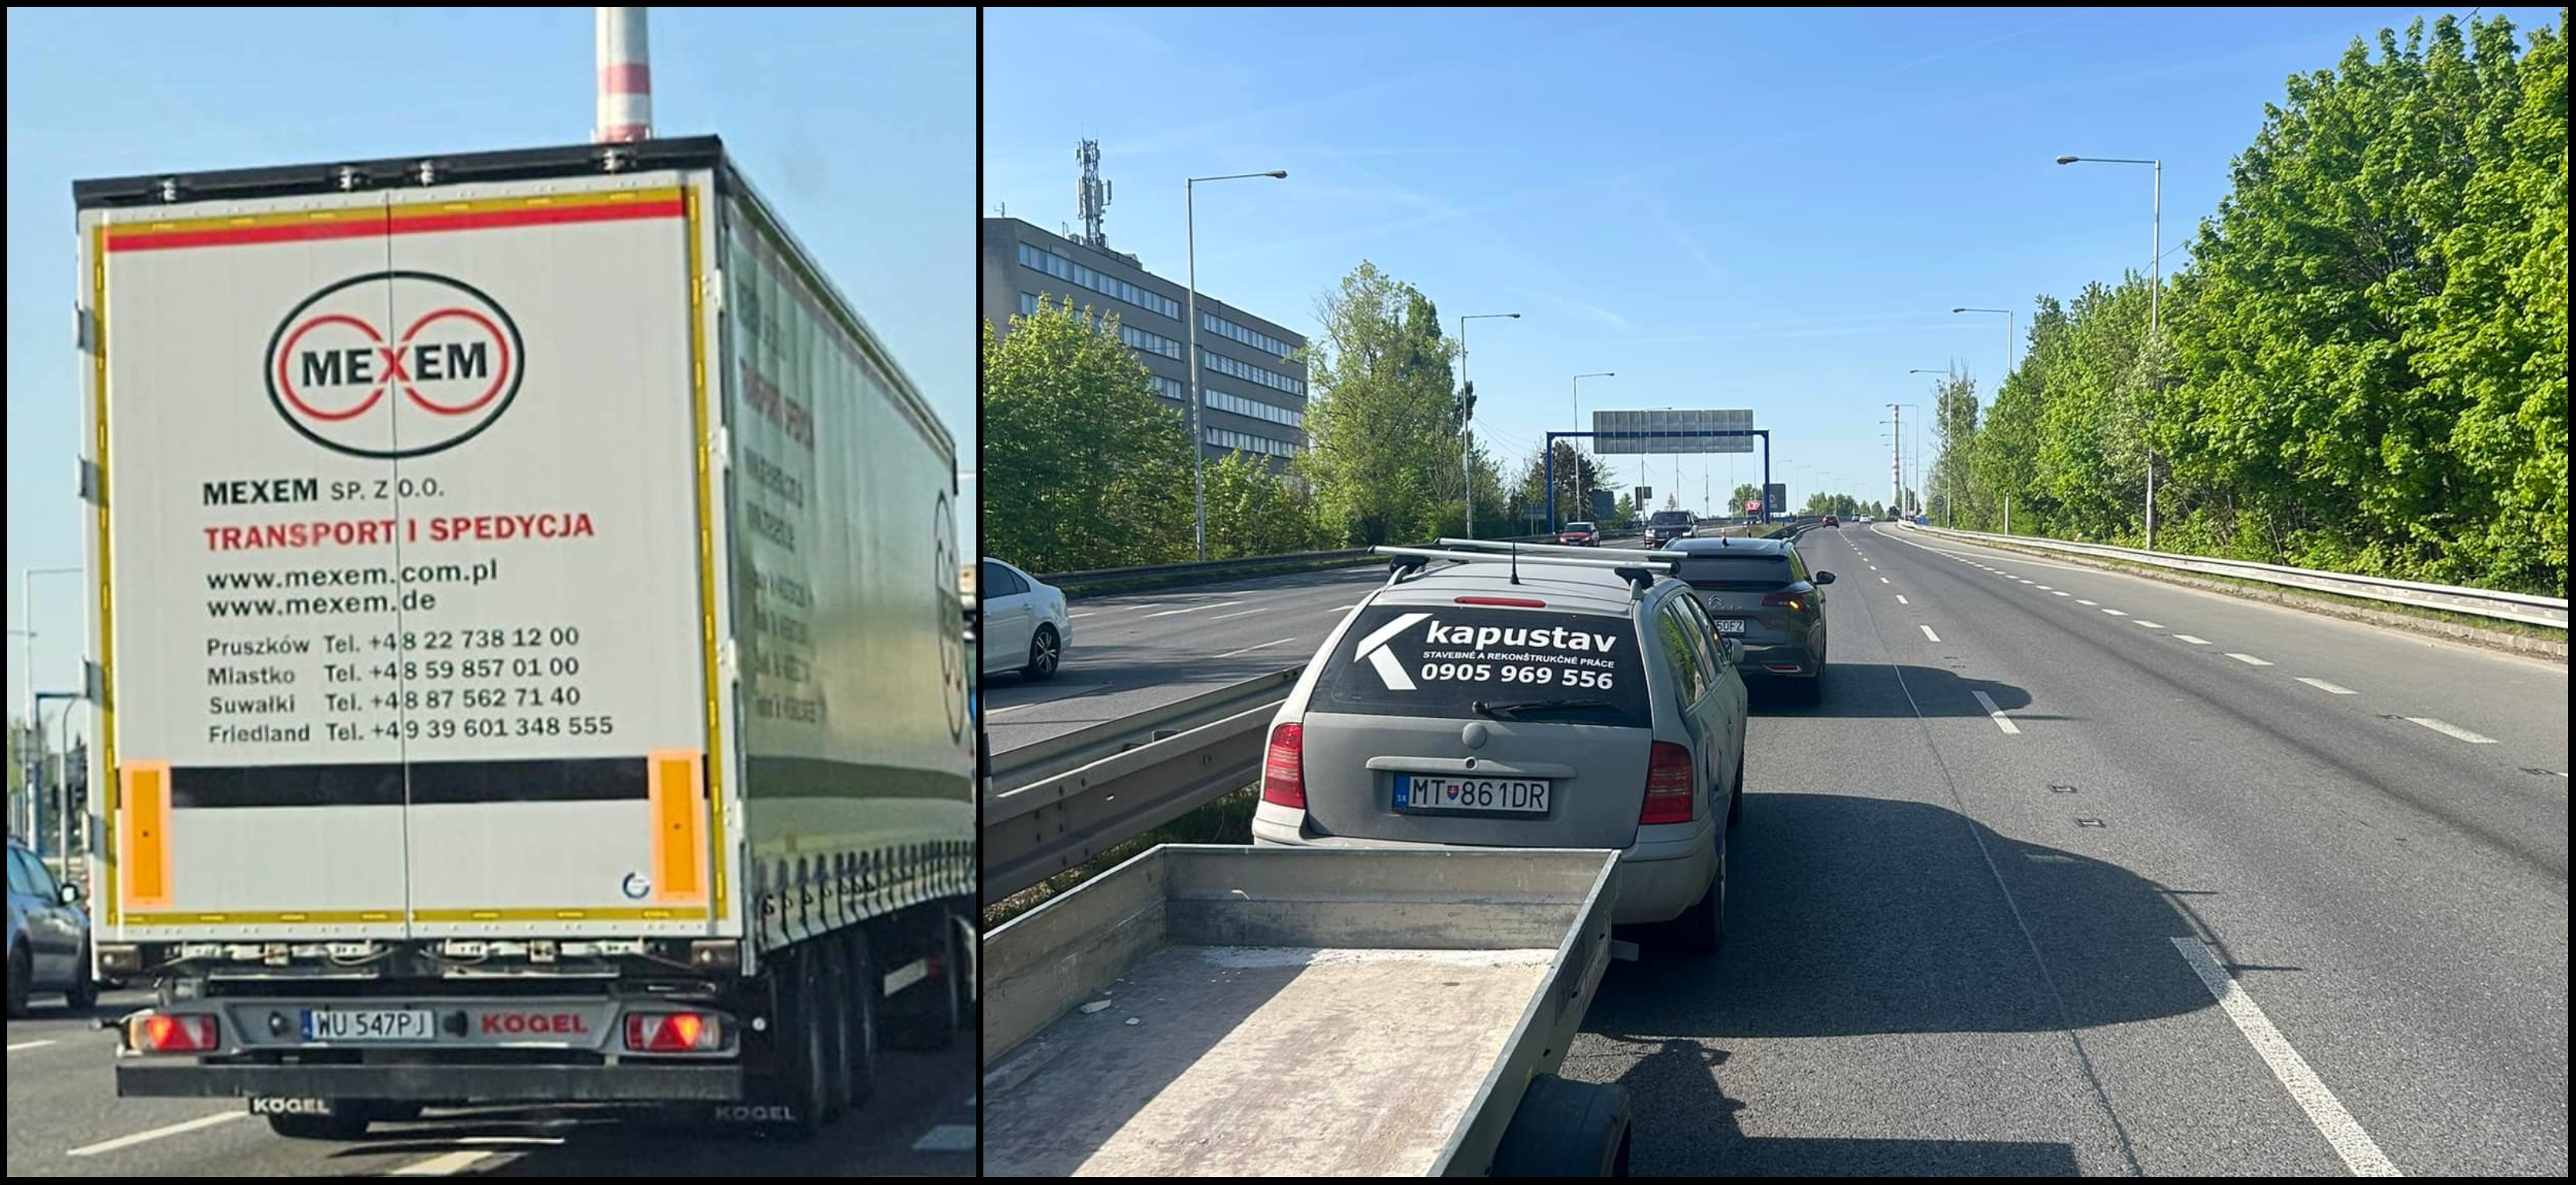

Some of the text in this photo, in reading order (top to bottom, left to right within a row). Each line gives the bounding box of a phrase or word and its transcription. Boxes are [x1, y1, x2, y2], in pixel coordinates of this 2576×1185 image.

[301, 341, 488, 387] MEXEM
[203, 478, 318, 506] MEXEM
[331, 480, 365, 500] SP.
[374, 480, 388, 499] Z
[204, 513, 593, 551] TRANSPORT I SPEDYCJA
[207, 558, 496, 589] www.mexem.com.pl
[207, 589, 436, 617] www.mexem.de
[207, 626, 579, 656] Pruszków Tel. +48 22 738 12 00
[1426, 620, 1617, 652] kapustav
[208, 656, 579, 686] Miastko Tel. +48 59 857 01 00
[1423, 651, 1615, 669] STAVEBNÉ A REKONŠTRUKČNÉ PRÁCE
[1421, 663, 1613, 690] 0905 969 556
[210, 686, 580, 714] Suwałki Tel. +48 87 562 71 40
[209, 716, 613, 743] Friedland Tel. +49 39 601 348 555
[316, 1013, 426, 1037] WU 547PJ
